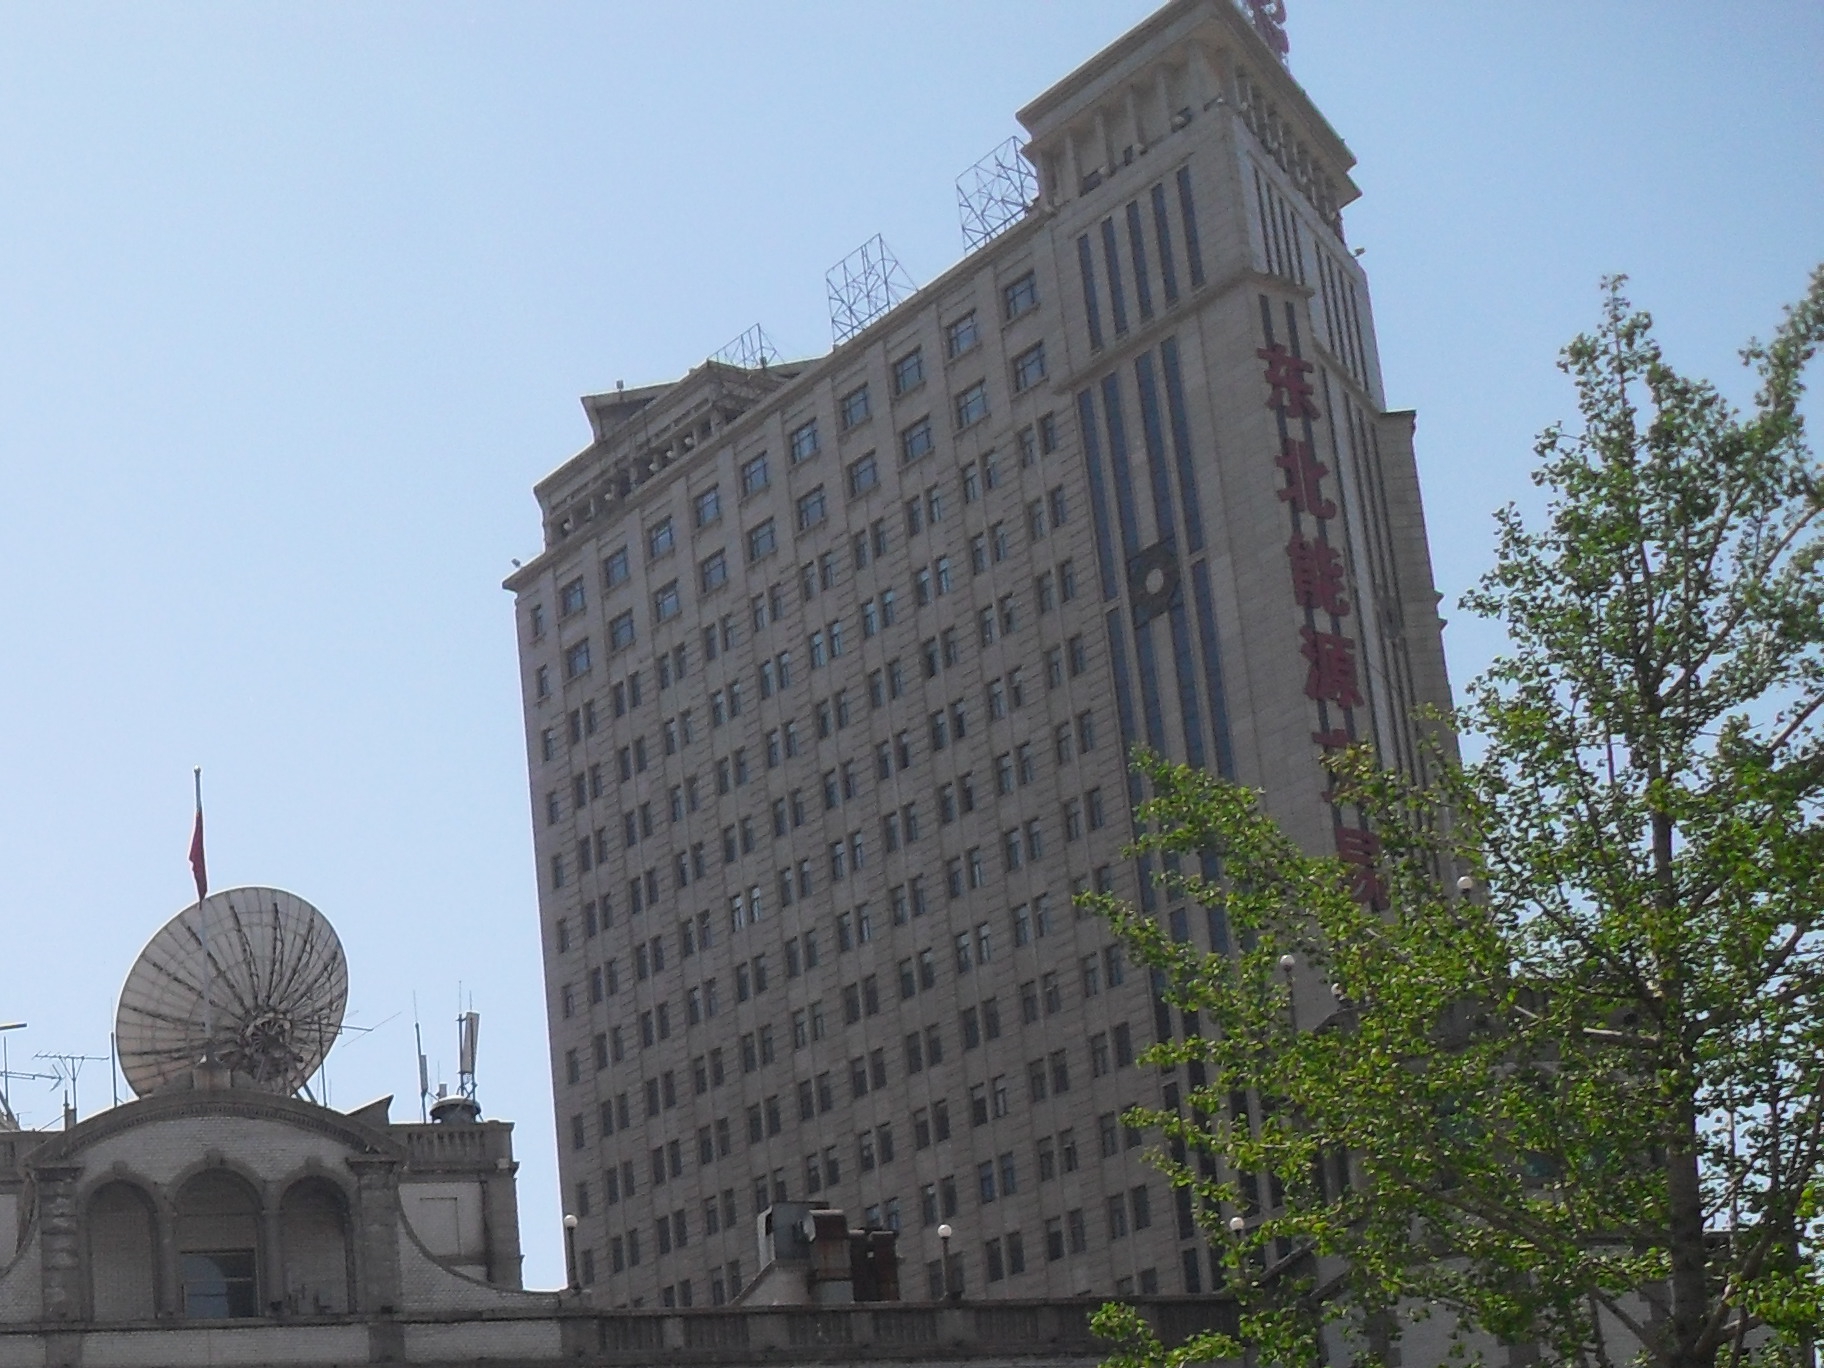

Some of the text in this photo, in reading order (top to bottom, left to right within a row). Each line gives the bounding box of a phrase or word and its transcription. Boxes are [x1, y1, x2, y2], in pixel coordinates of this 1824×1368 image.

[1257, 343, 1390, 912] 东北能源易
